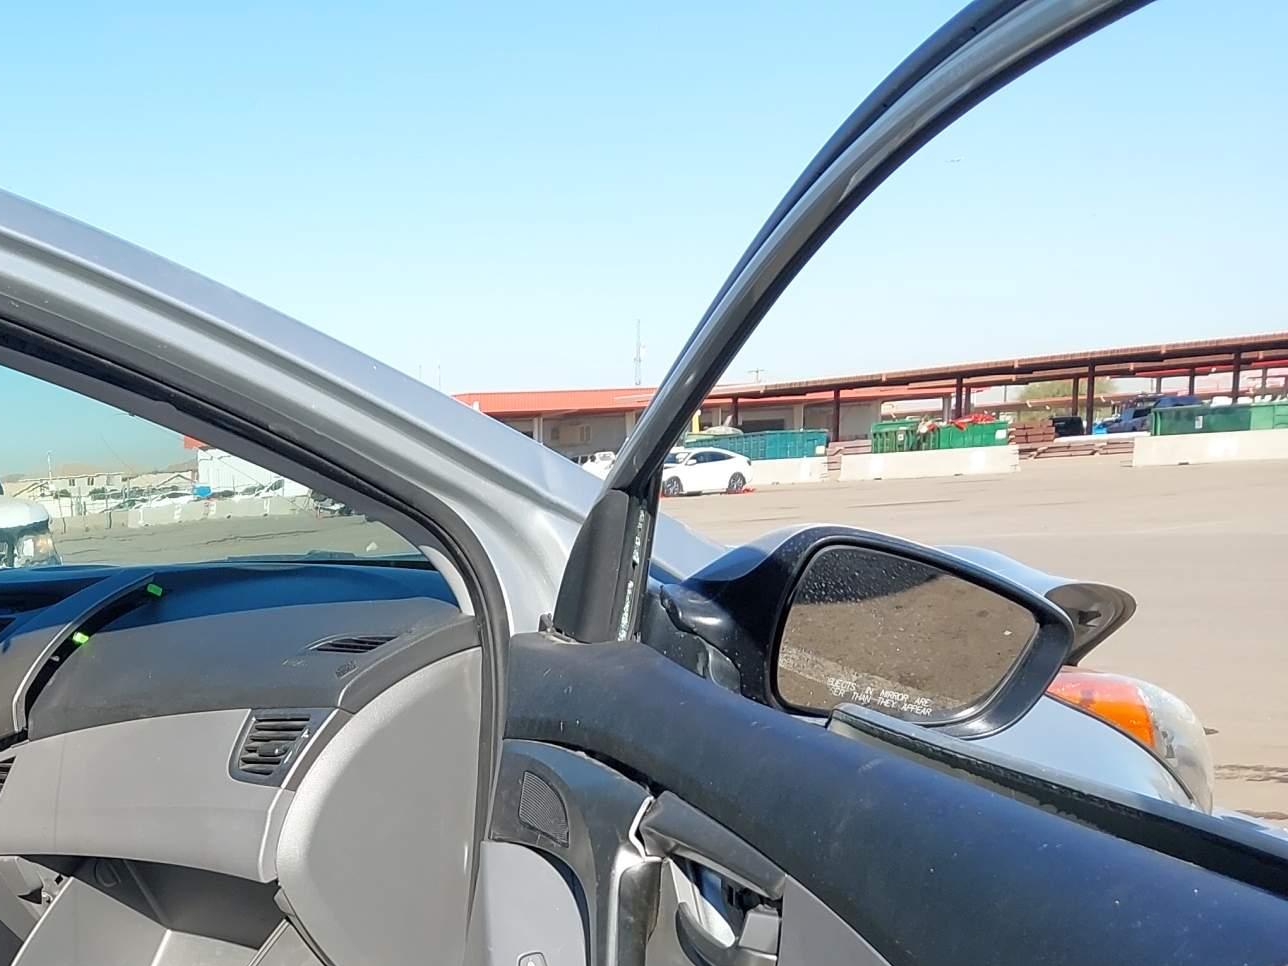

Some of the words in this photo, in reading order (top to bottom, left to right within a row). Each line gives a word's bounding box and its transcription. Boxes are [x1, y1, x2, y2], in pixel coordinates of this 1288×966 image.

[827, 677, 857, 692] BJECTS
[879, 688, 910, 702] MIRROR
[915, 697, 933, 708] ARE
[851, 691, 873, 705] THAN
[876, 696, 898, 709] THEY
[901, 703, 933, 716] APPEAR
